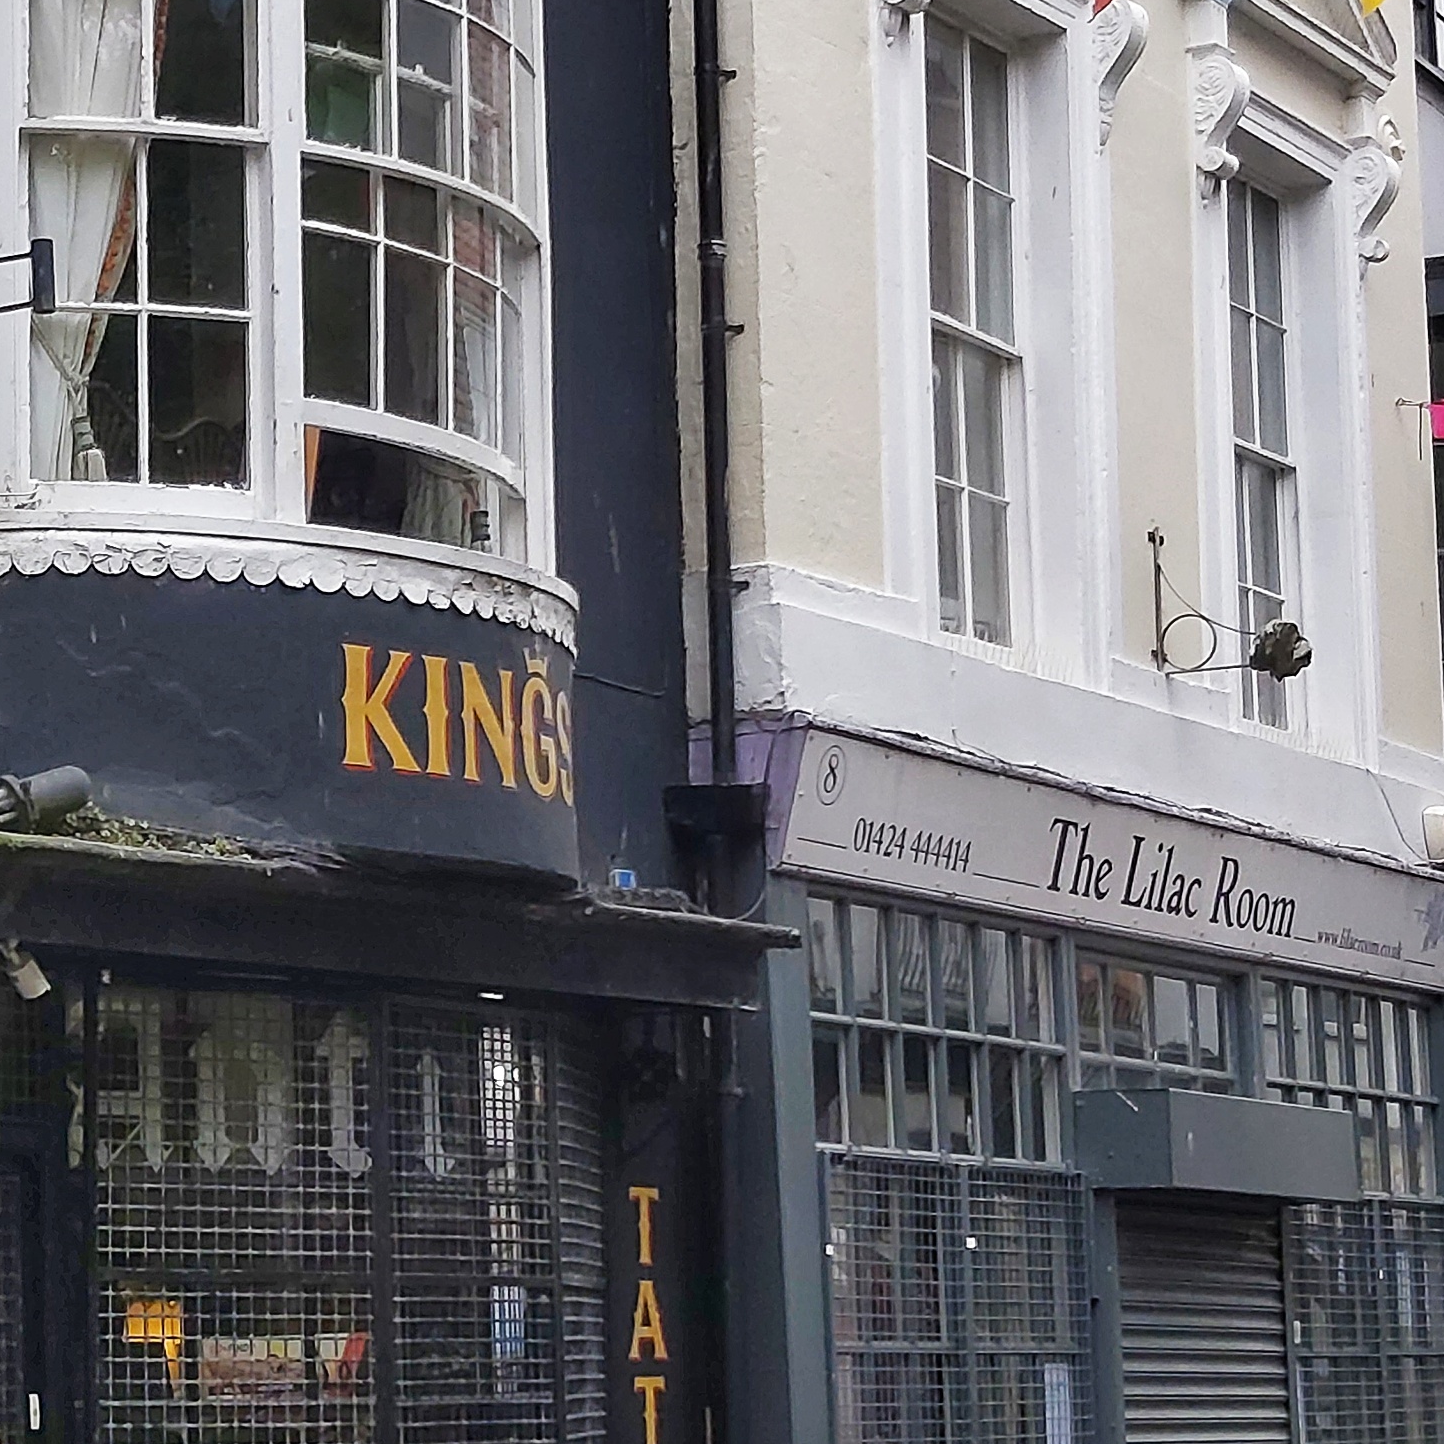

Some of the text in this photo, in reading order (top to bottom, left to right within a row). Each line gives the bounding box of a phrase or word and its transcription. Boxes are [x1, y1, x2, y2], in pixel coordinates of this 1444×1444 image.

[341, 641, 575, 807] KINGS
[823, 753, 840, 794] 8
[853, 817, 972, 874] 01424 444414
[1045, 817, 1299, 939] The Lilac Room
